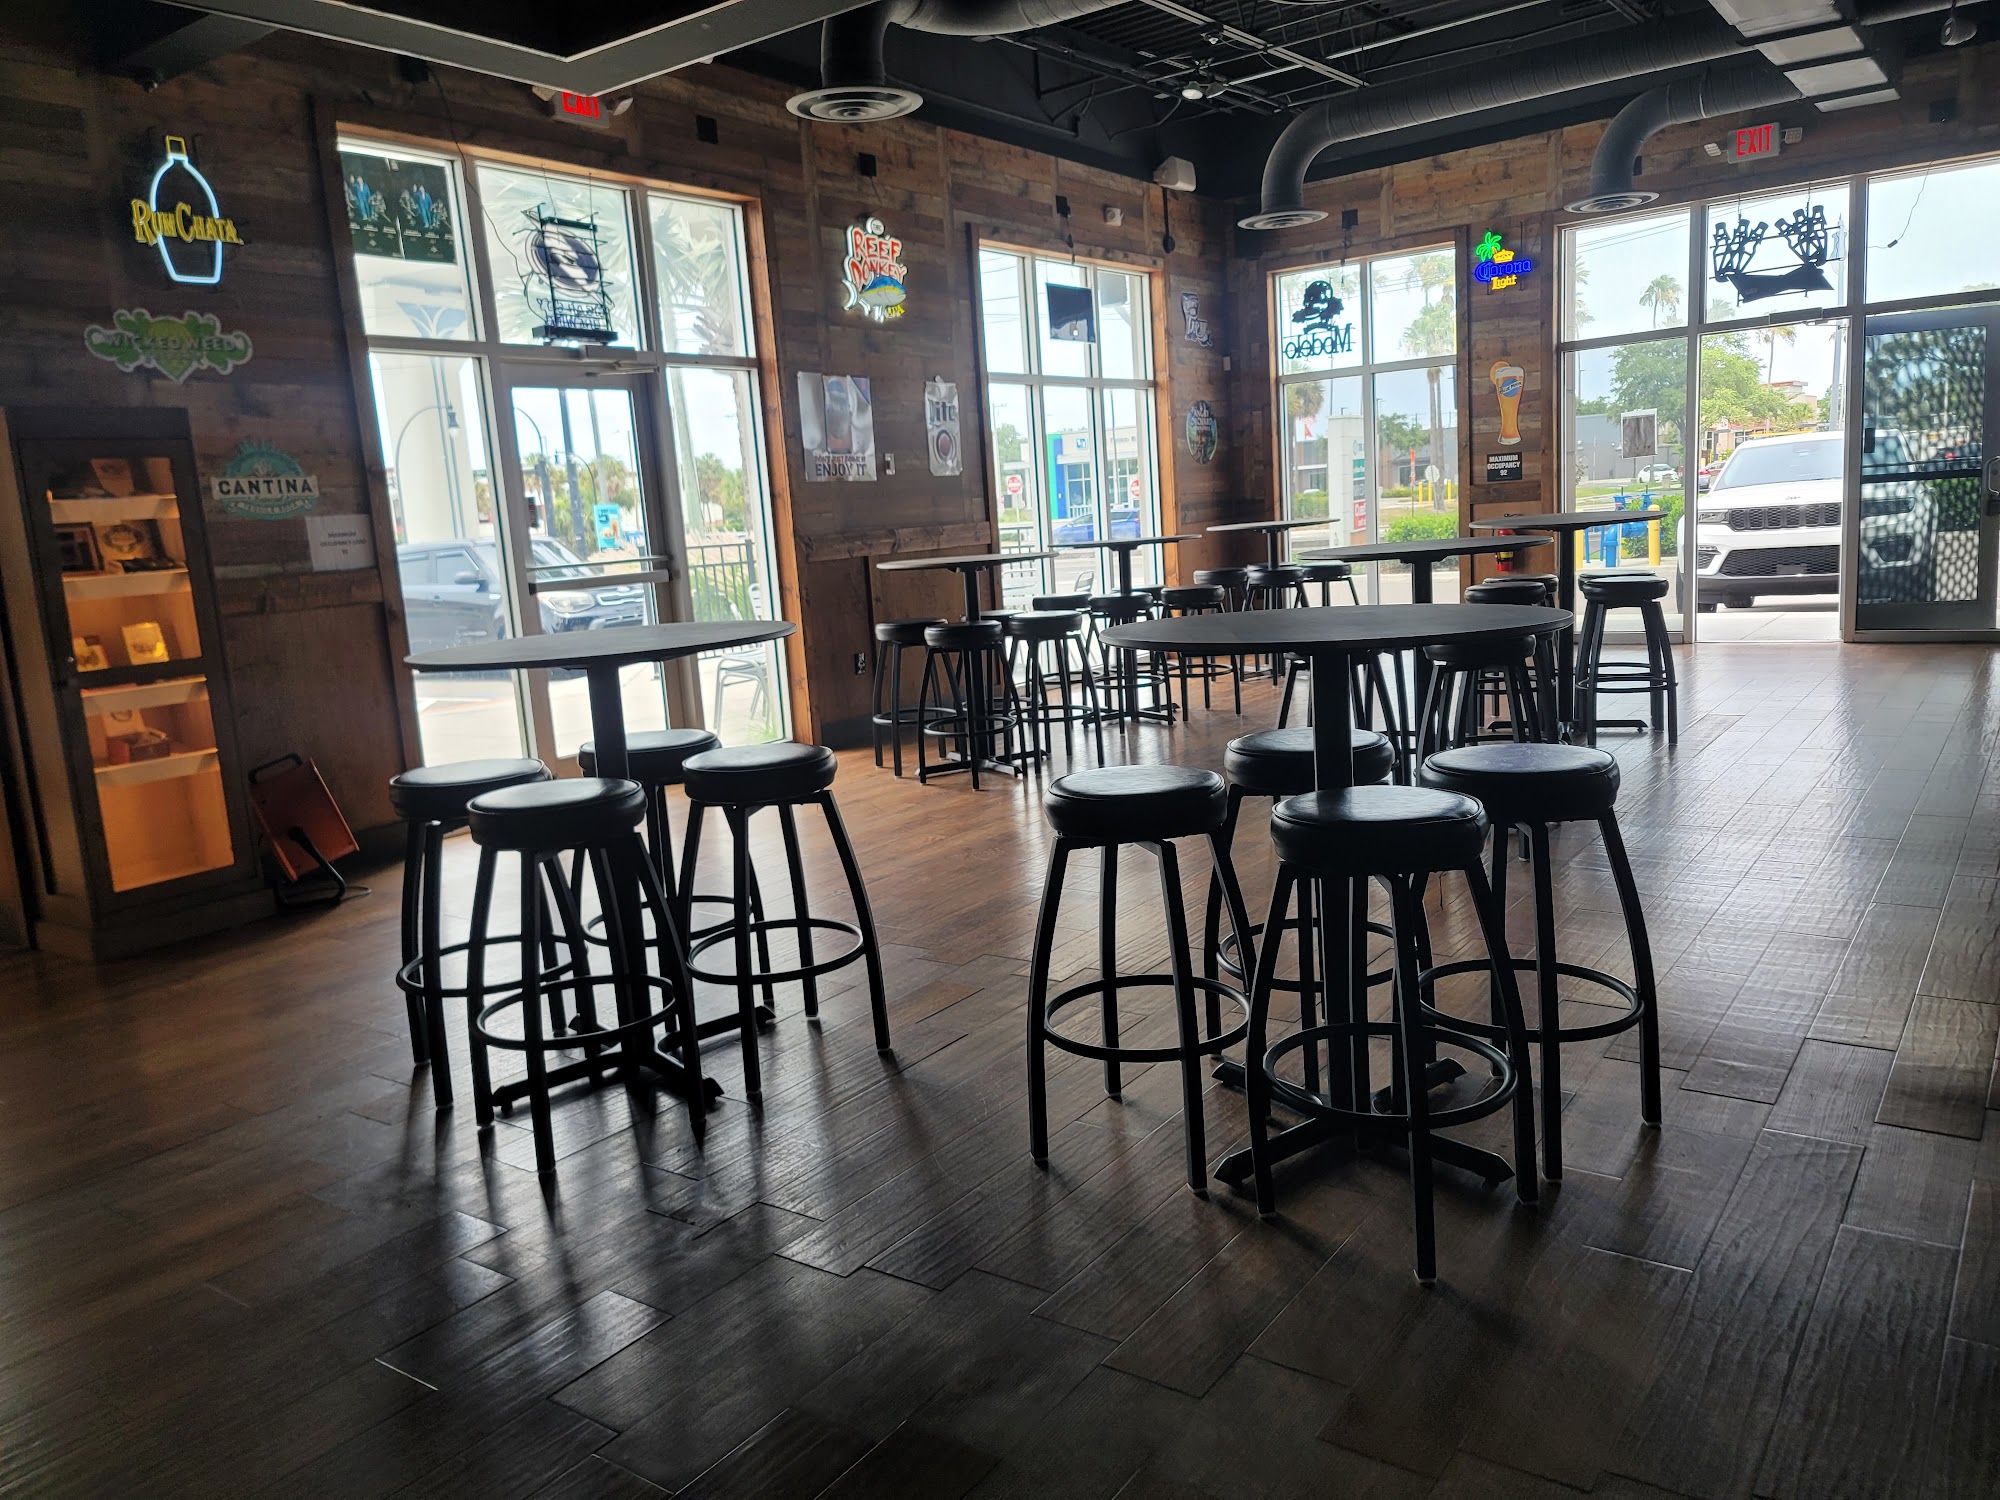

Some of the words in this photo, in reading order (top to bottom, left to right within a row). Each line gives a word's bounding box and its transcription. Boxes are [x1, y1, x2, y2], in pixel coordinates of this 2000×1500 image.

[1736, 125, 1773, 156] EXIT
[852, 229, 901, 263] REEF
[850, 258, 907, 292] DONKEY
[1475, 260, 1531, 282] Corona
[1491, 275, 1517, 290] Light
[815, 463, 853, 476] ENJOY
[856, 463, 867, 476] IT
[1487, 462, 1520, 470] OCCUPANCY
[218, 479, 312, 495] CANTINA
